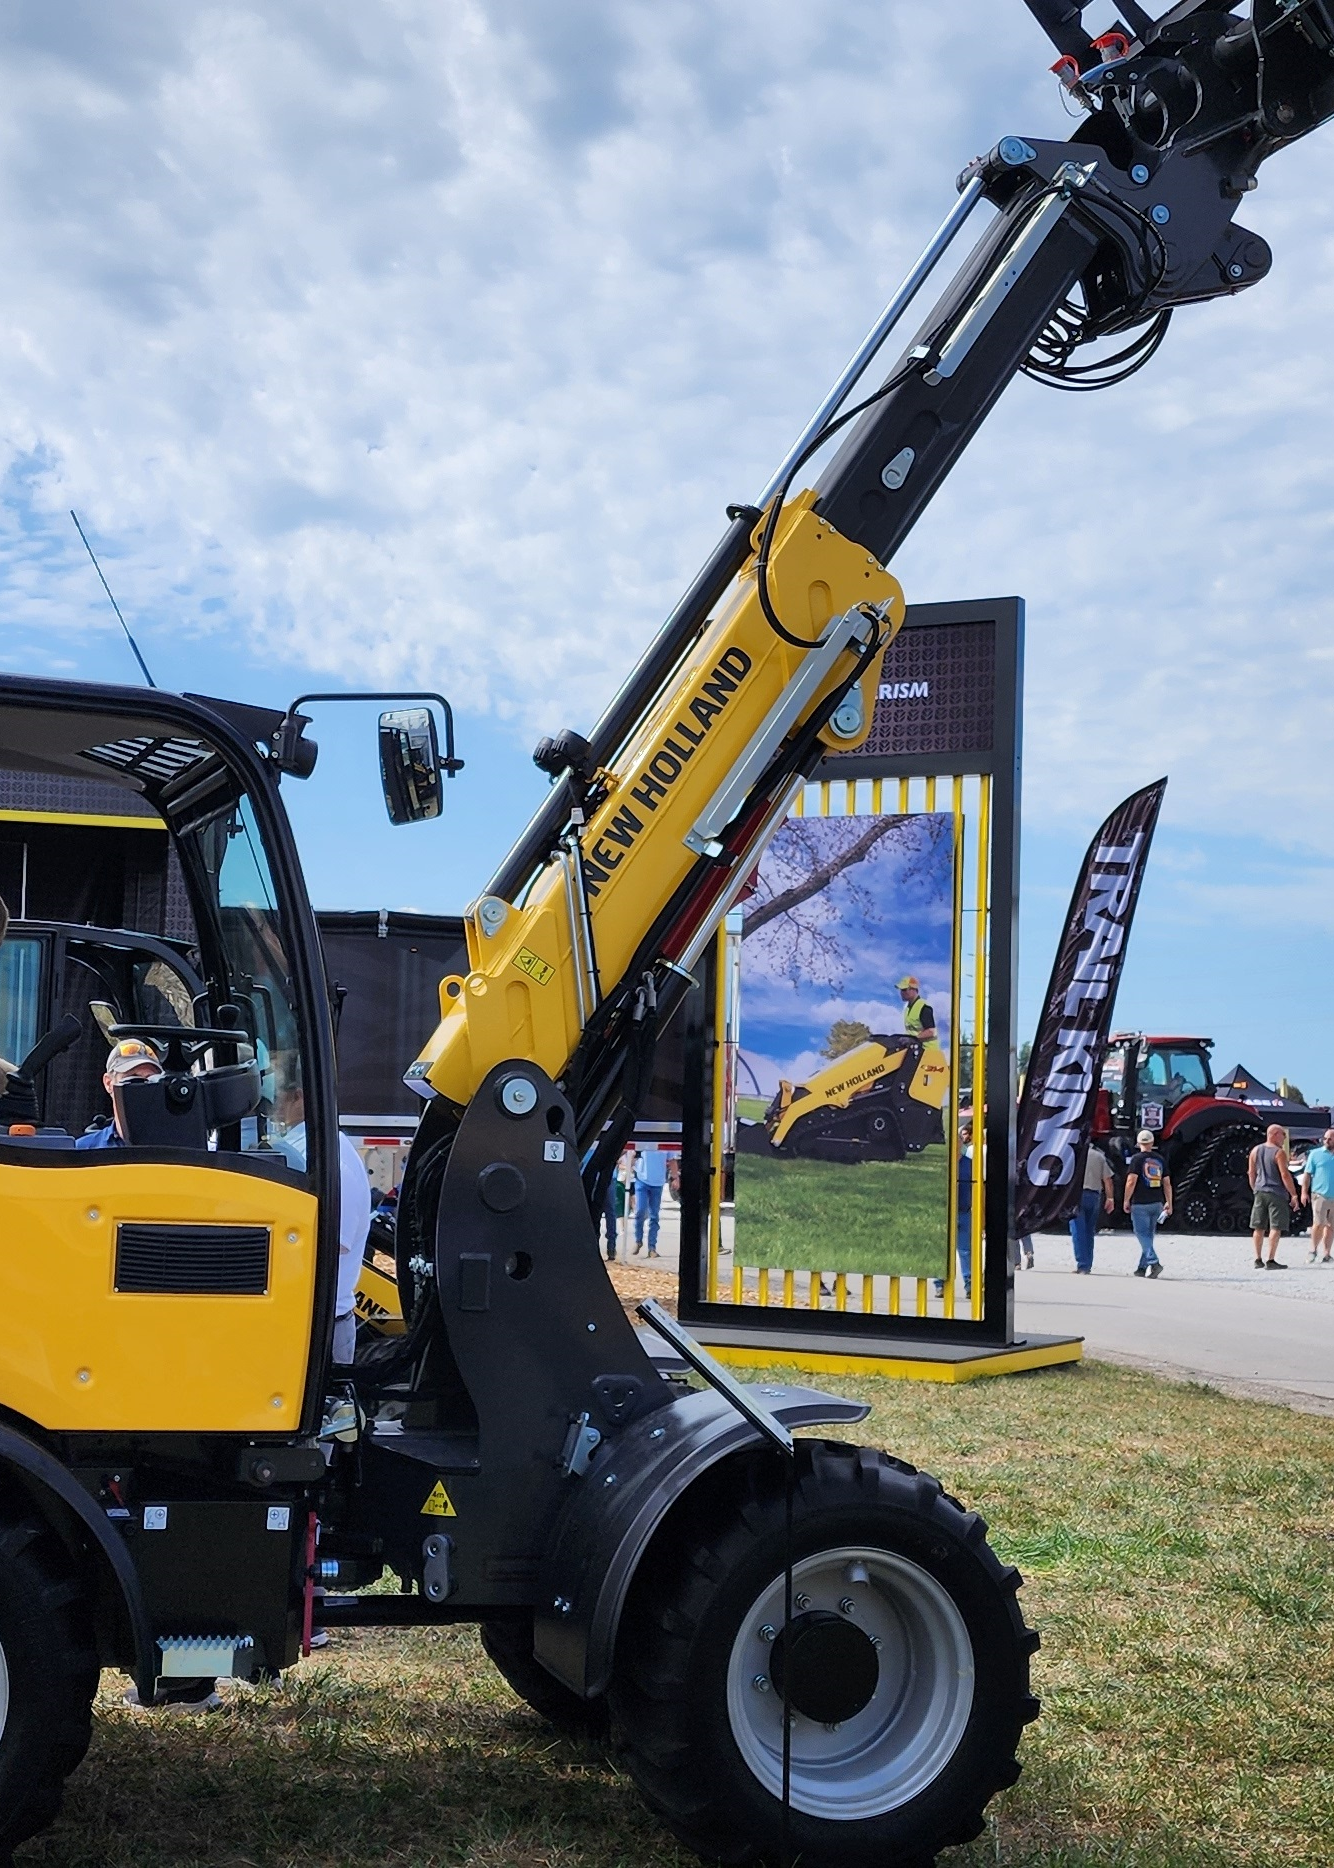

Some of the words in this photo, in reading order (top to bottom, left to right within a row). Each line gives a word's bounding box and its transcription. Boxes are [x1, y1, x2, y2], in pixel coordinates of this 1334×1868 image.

[875, 681, 928, 700] RISM
[573, 804, 645, 898] NEW
[630, 646, 753, 812] HOLLAND
[1063, 831, 1145, 1018] TRAIL
[825, 1083, 846, 1099] NEW
[847, 1063, 886, 1088] HOLLAND
[1026, 1027, 1099, 1187] KING
